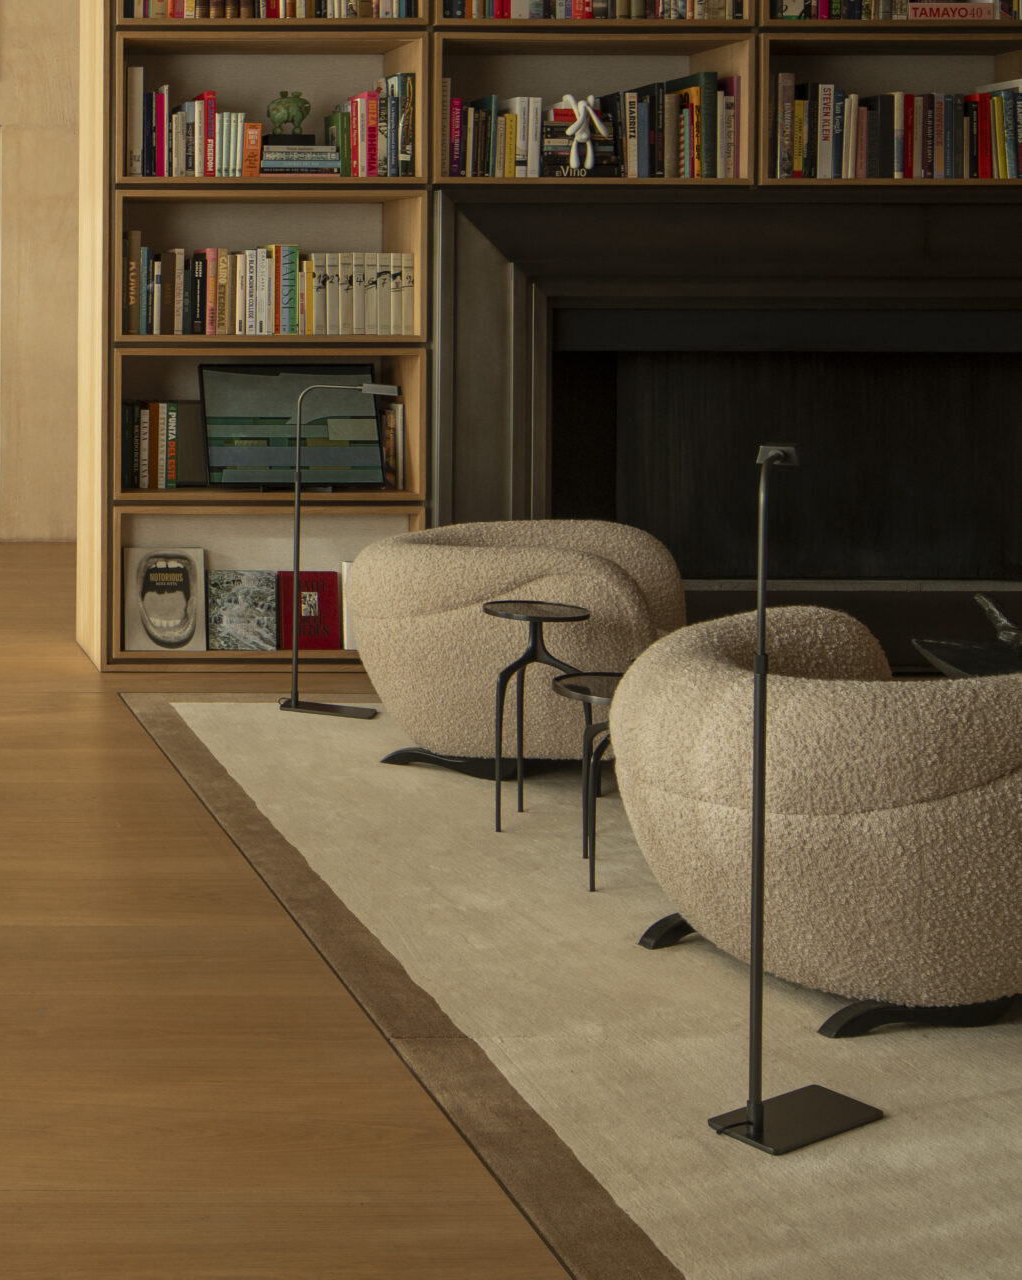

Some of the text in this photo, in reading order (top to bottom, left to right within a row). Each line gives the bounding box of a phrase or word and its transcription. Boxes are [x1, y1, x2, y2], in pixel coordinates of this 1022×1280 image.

[912, 7, 968, 18] TAMAYO
[368, 100, 377, 171] IBIZA BOHEMIA
[822, 87, 832, 141] STEVEN KLEIN
[833, 101, 844, 134] Van Gogh
[936, 101, 944, 146] PROVENCE
[560, 165, 587, 177] Vino
[128, 261, 137, 305] KUMA
[218, 256, 227, 328] CAIRO ETERNAL
[281, 250, 296, 314] MATISSE
[167, 411, 177, 480] PUNTA DEL ESTE
[150, 573, 183, 582] NOTORIOUS
